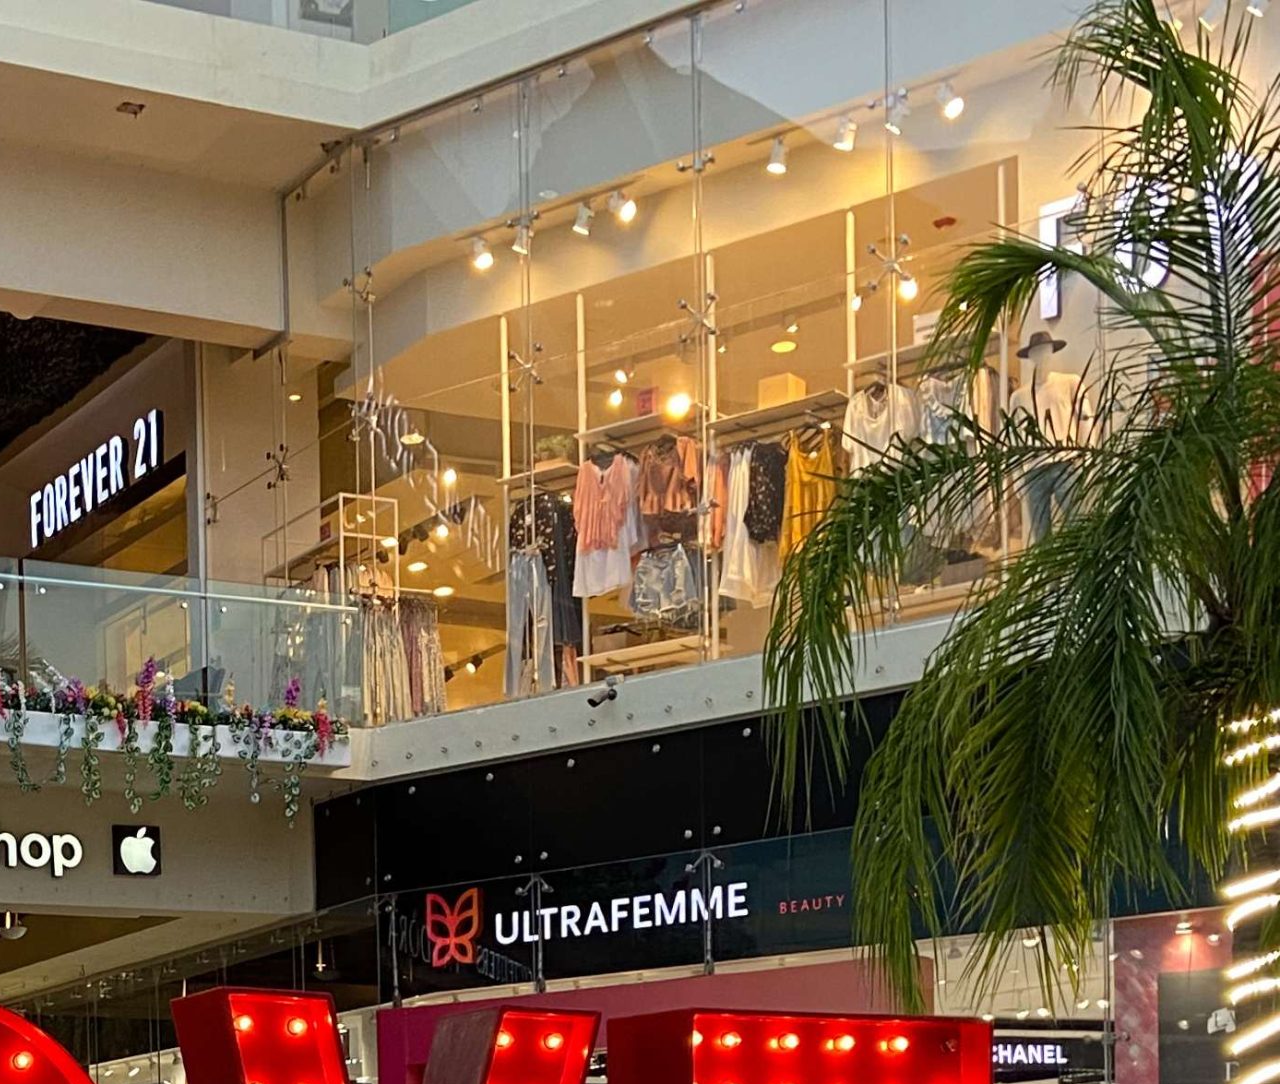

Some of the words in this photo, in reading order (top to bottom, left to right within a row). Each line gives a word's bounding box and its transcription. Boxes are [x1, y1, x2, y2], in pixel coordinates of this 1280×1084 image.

[30, 435, 124, 549] FOREVER
[133, 408, 158, 479] 21
[494, 882, 750, 945] ULTRAFEMME
[778, 894, 846, 915] BEAUTY
